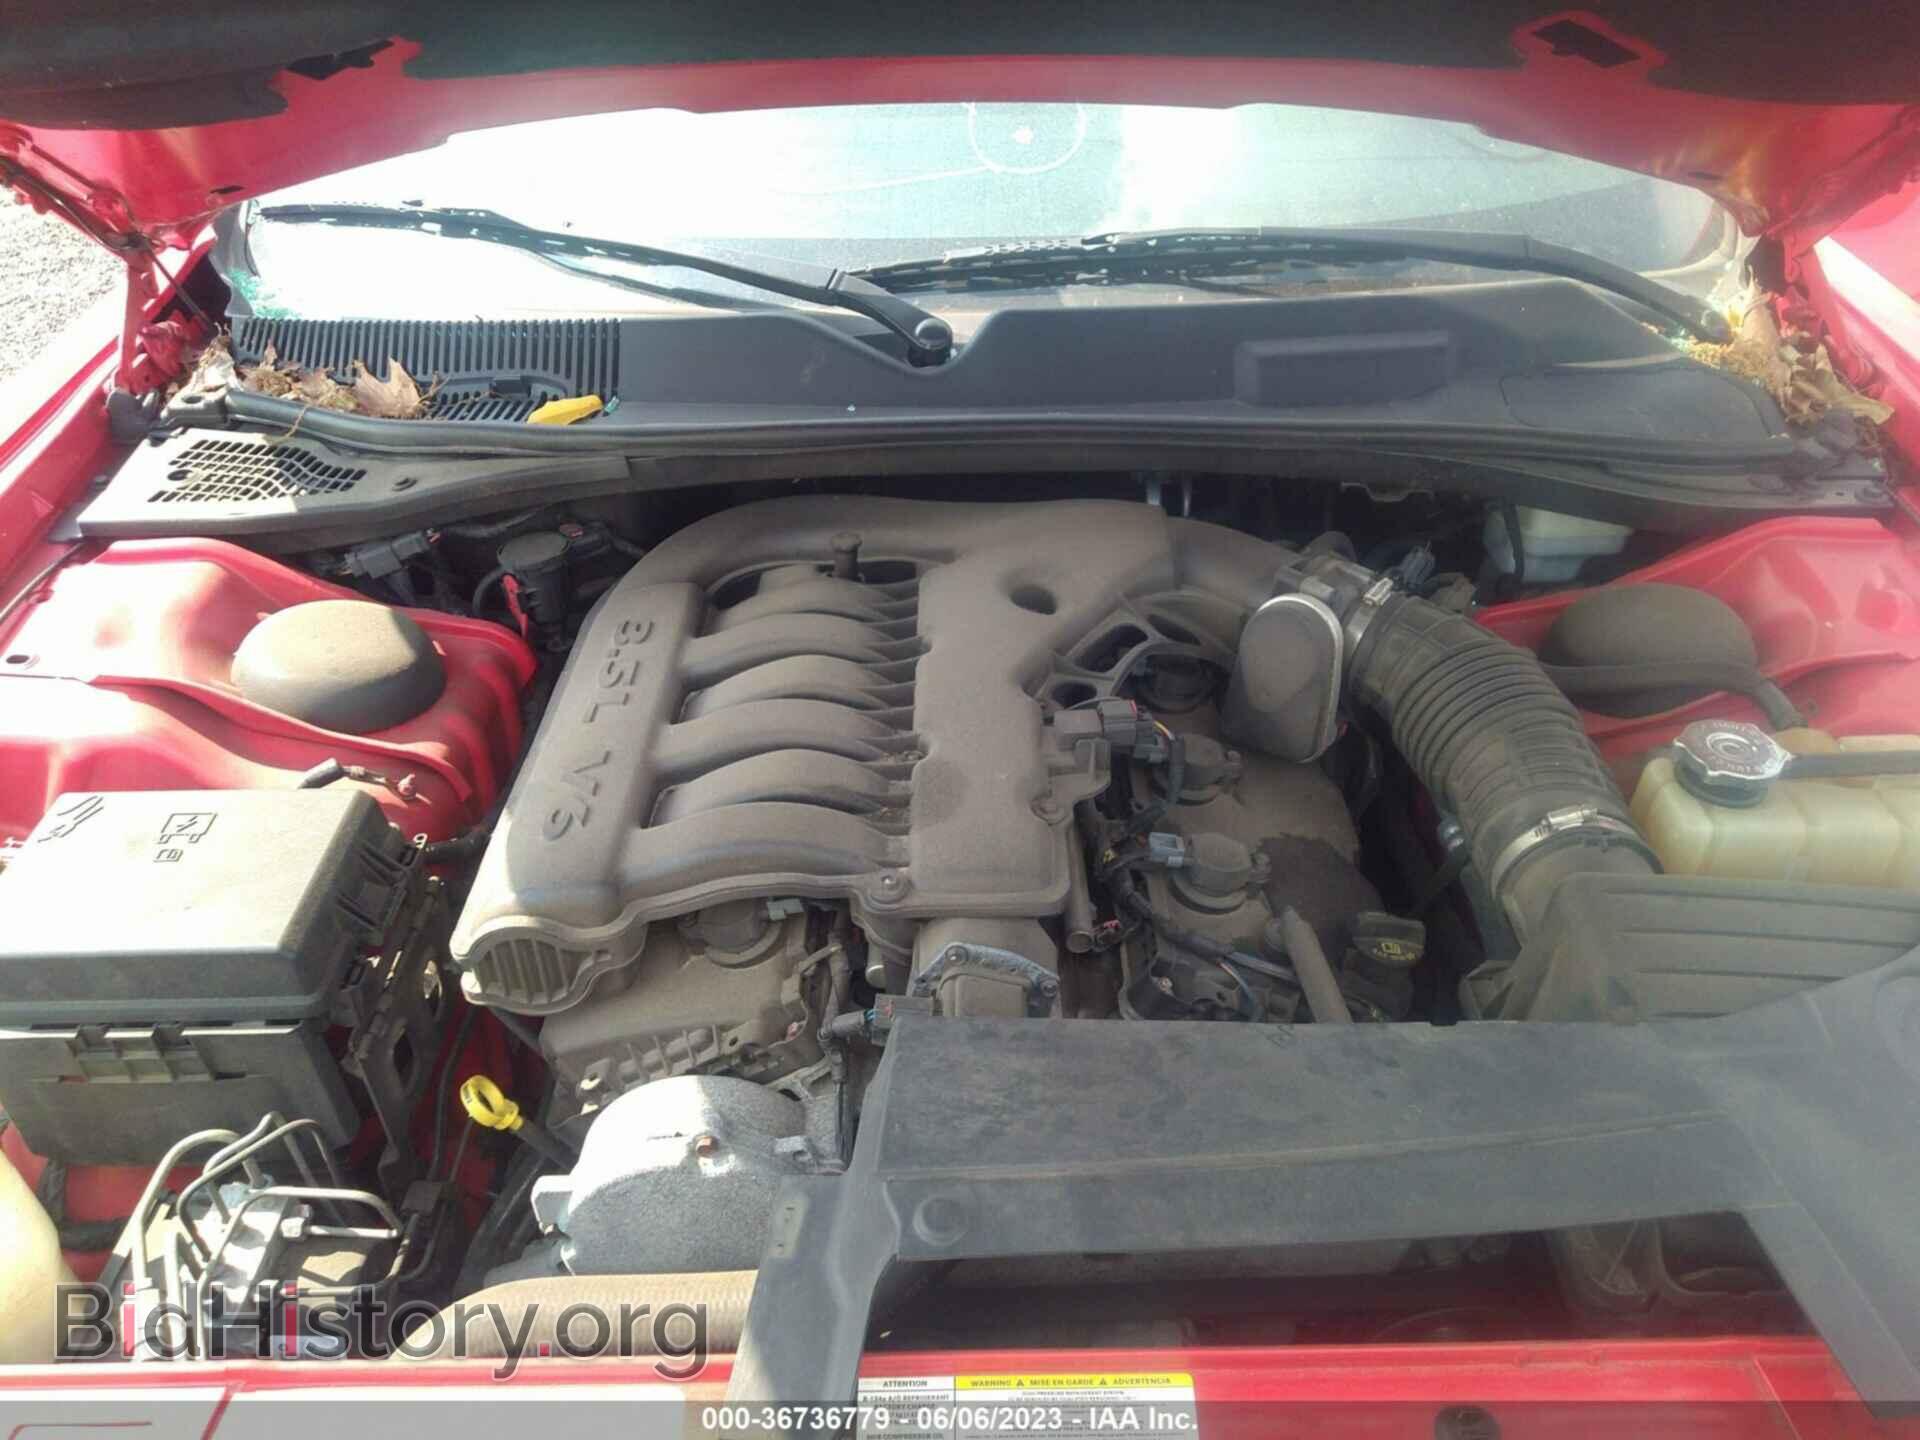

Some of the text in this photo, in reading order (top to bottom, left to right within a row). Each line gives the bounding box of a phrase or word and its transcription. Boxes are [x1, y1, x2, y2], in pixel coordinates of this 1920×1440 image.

[543, 619, 655, 841] 3.5L V6
[883, 1380, 928, 1388] ATTENTION
[970, 1379, 1011, 1387] WARNING
[1066, 1378, 1094, 1386] GARDE
[1113, 1377, 1171, 1385] ADVERTENCIA
